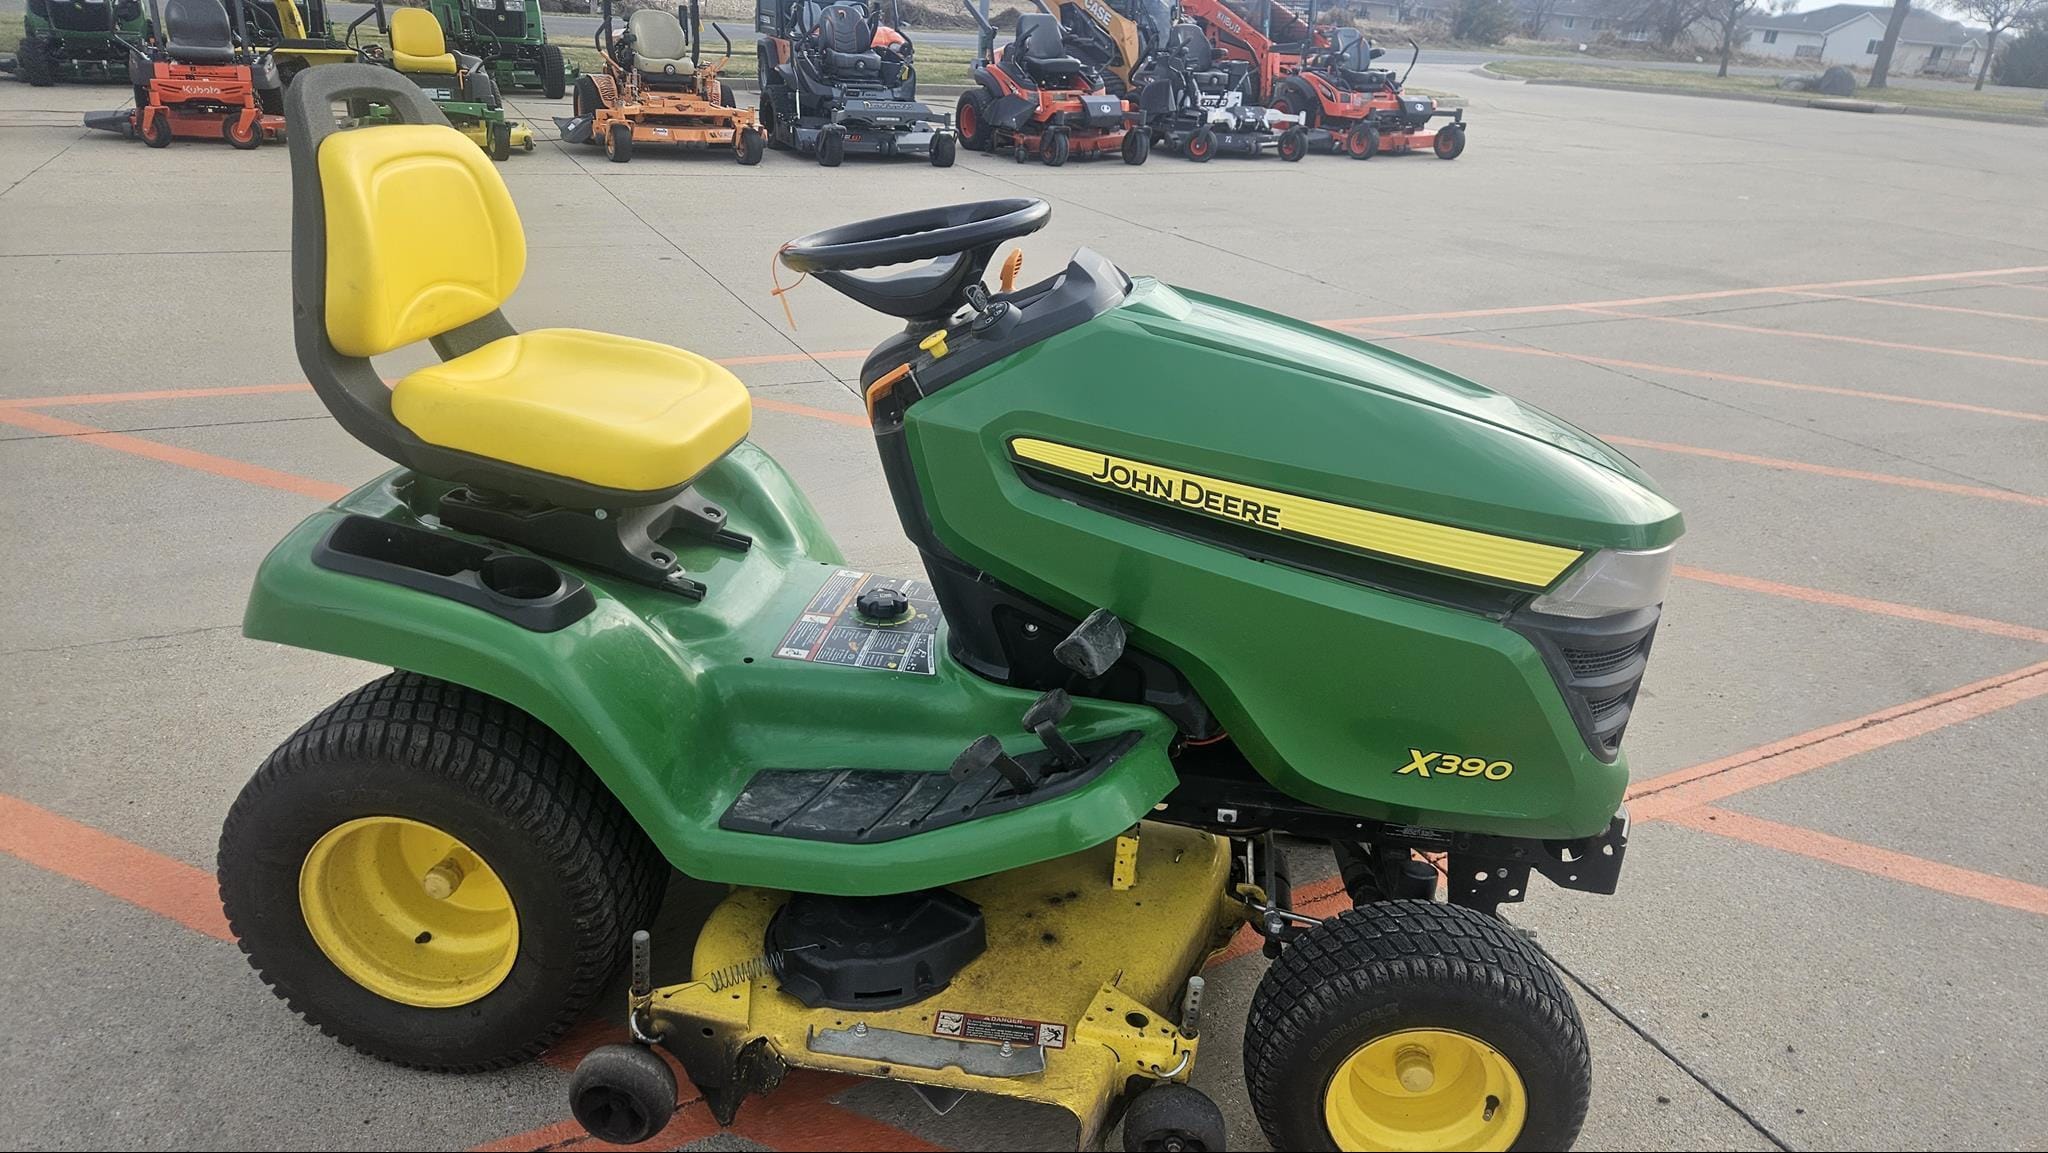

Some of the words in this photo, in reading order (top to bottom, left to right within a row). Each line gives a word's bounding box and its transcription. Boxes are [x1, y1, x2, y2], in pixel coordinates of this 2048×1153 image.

[1085, 0, 1112, 26] CASE
[182, 85, 221, 94] Kubota
[1092, 457, 1174, 498] JOHN
[1180, 479, 1281, 528] DEERE
[1395, 749, 1514, 781] X390
[991, 1016, 1023, 1024] DANGER
